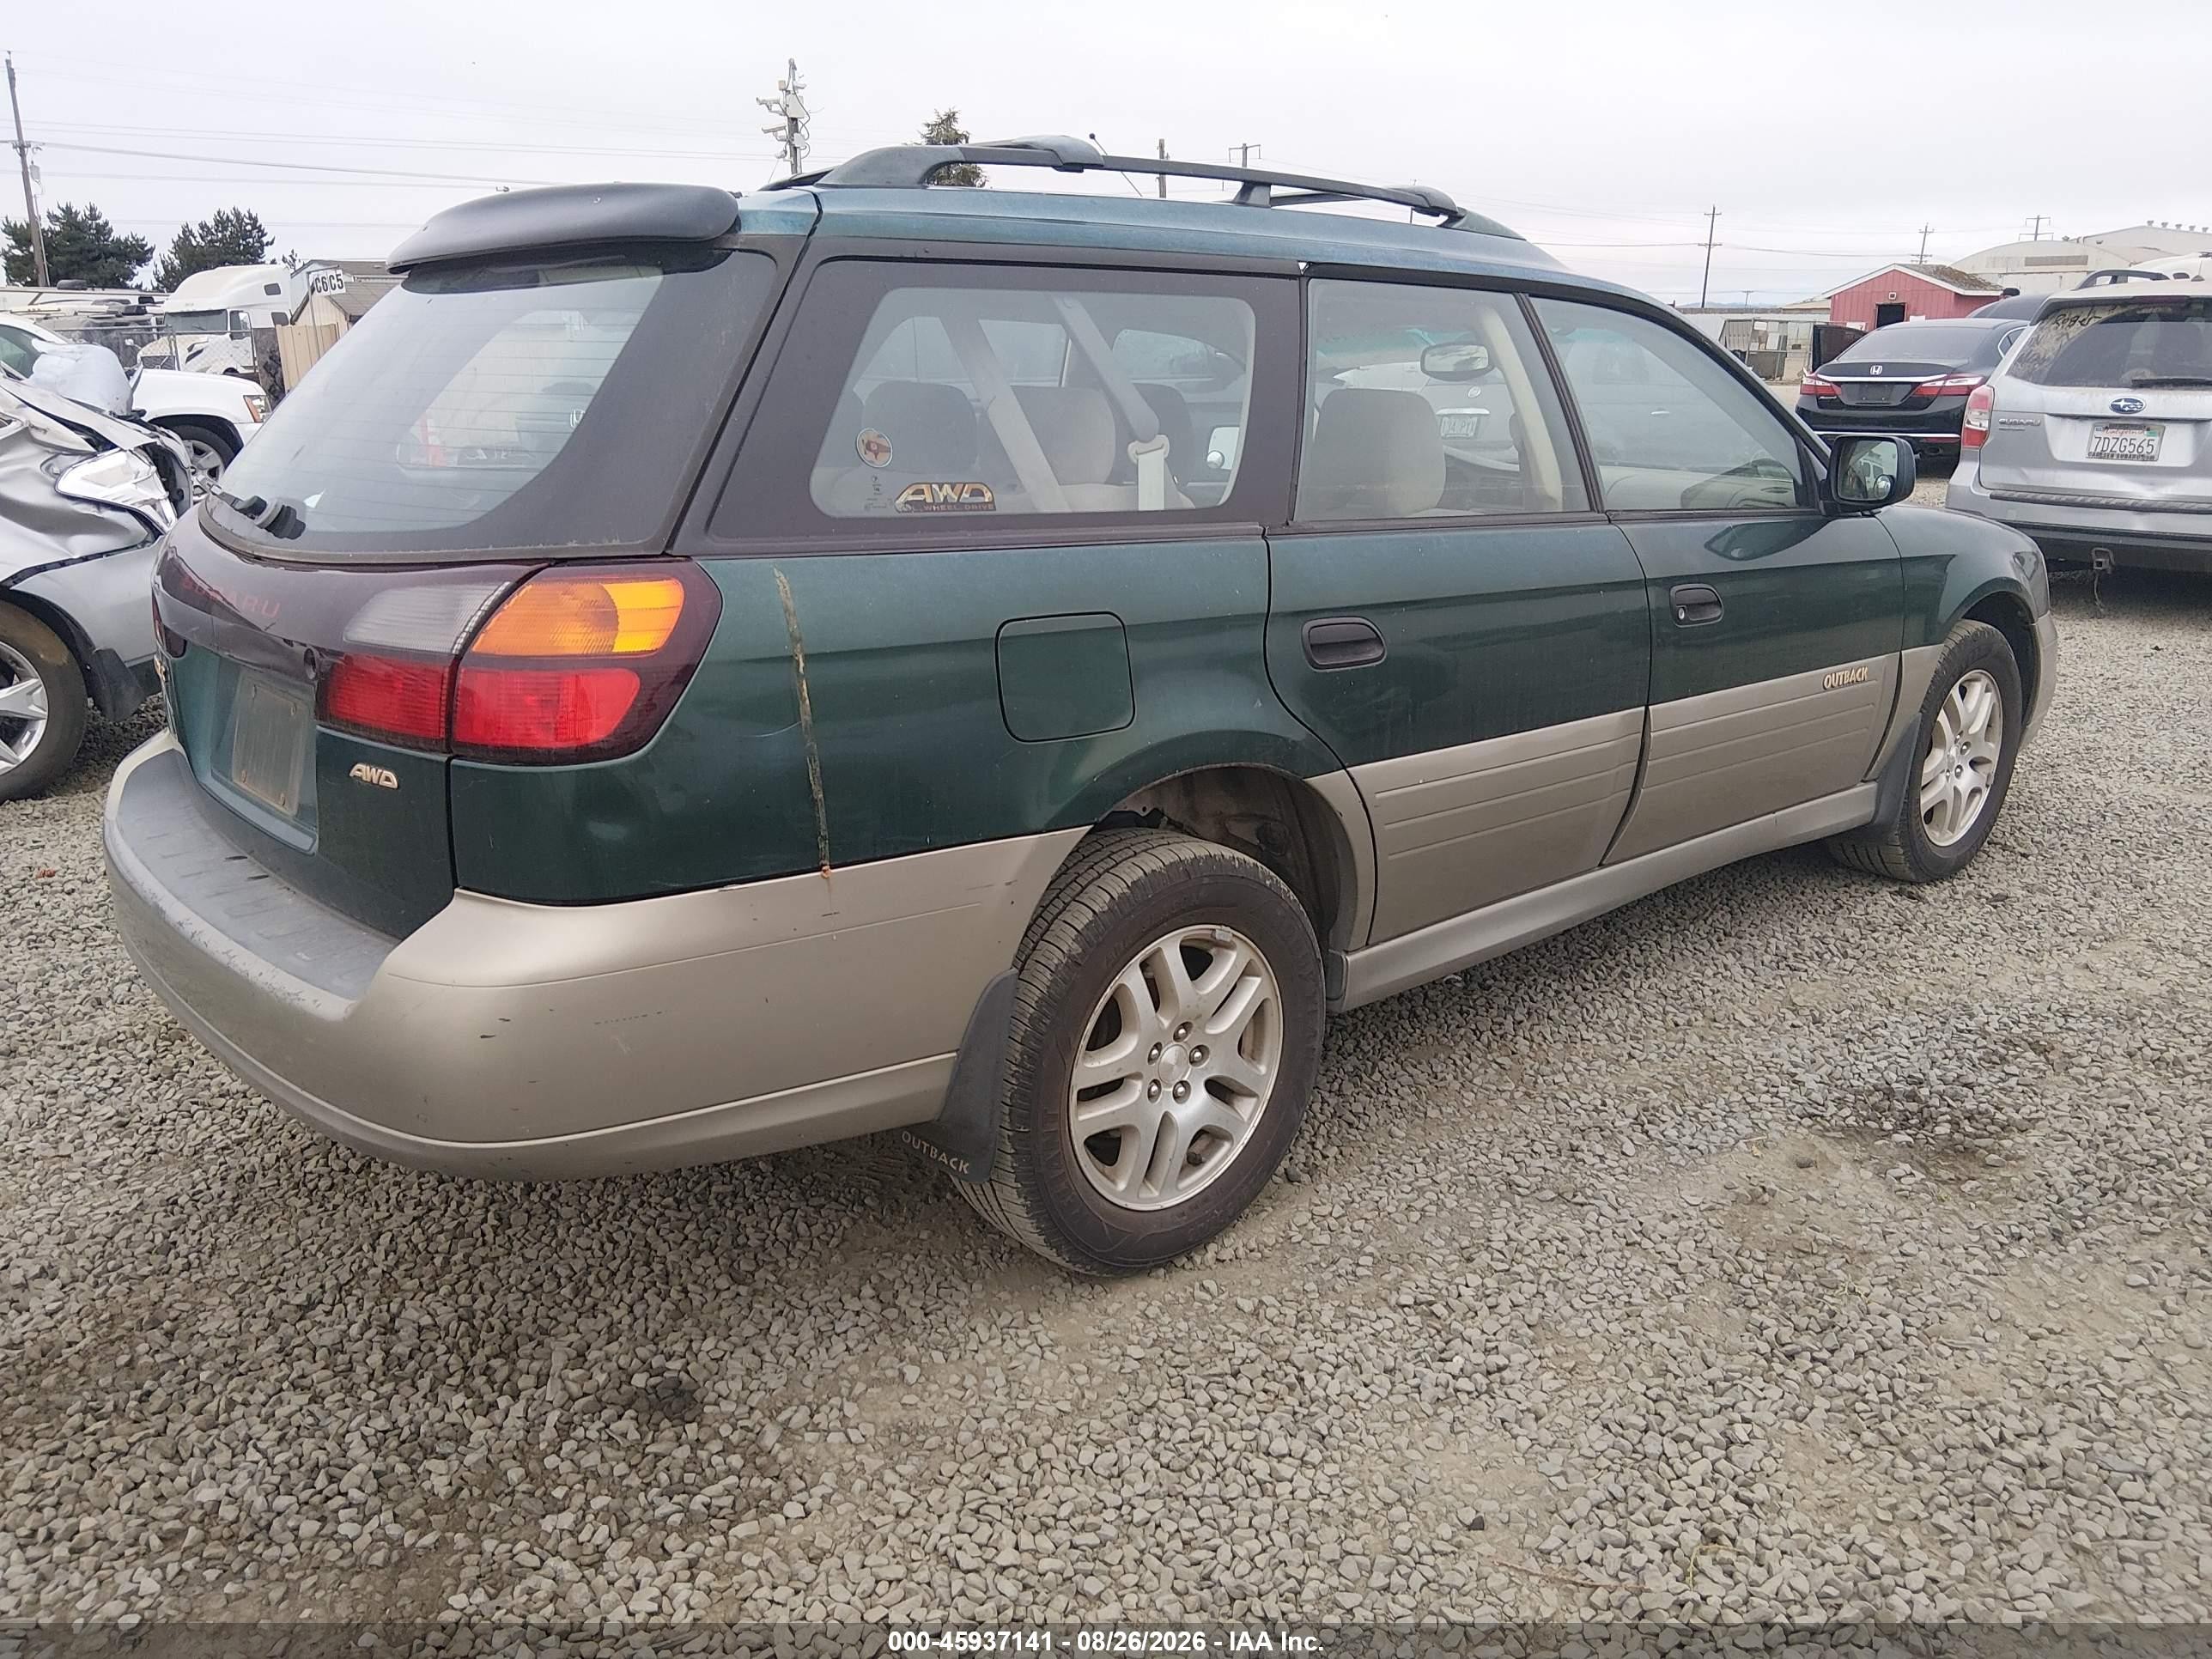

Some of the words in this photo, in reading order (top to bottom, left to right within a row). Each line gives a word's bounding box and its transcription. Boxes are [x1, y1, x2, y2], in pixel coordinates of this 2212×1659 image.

[314, 276, 329, 294] C6
[329, 274, 344, 291] C5
[1998, 418, 2041, 427] SUBARU
[2094, 436, 2156, 455] 7DZG565
[895, 483, 994, 504] AWD
[963, 502, 994, 512] DRIVE
[1823, 665, 1869, 690] OUTBACK
[349, 763, 398, 789] AWD
[902, 1130, 969, 1175] OUTBACK
